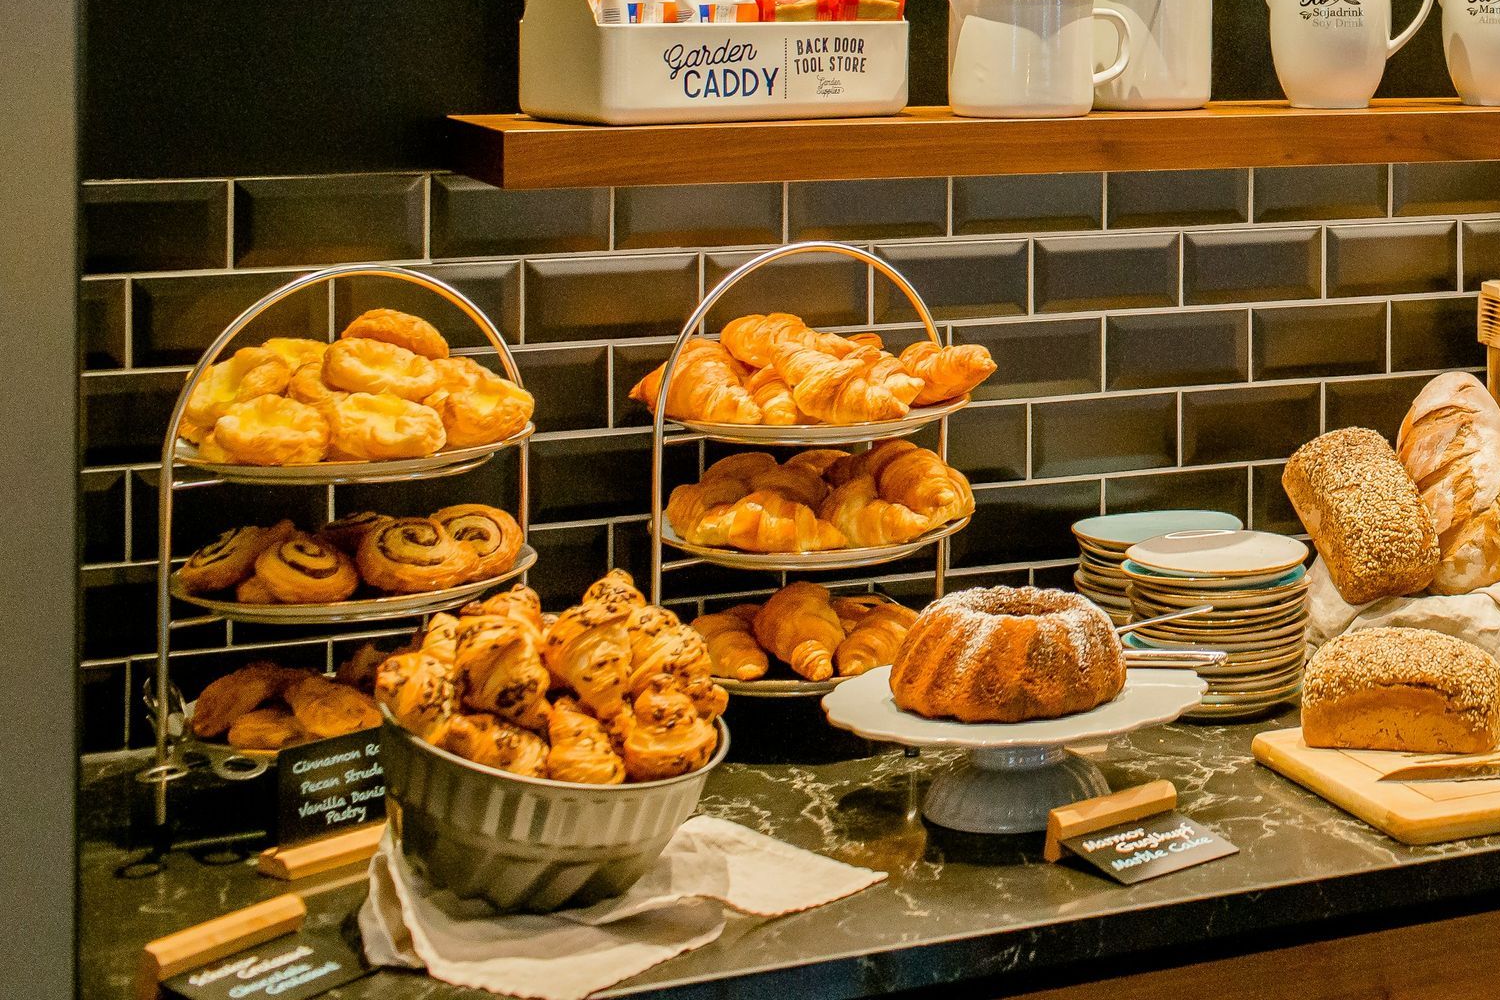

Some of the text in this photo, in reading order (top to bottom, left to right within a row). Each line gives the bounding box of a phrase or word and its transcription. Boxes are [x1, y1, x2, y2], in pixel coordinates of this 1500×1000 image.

[1312, 7, 1364, 19] Sojadrink
[796, 36, 865, 56] BACK DOOR
[663, 37, 758, 80] Garden
[793, 55, 867, 75] TOOL STORE
[683, 66, 780, 99] CADDY
